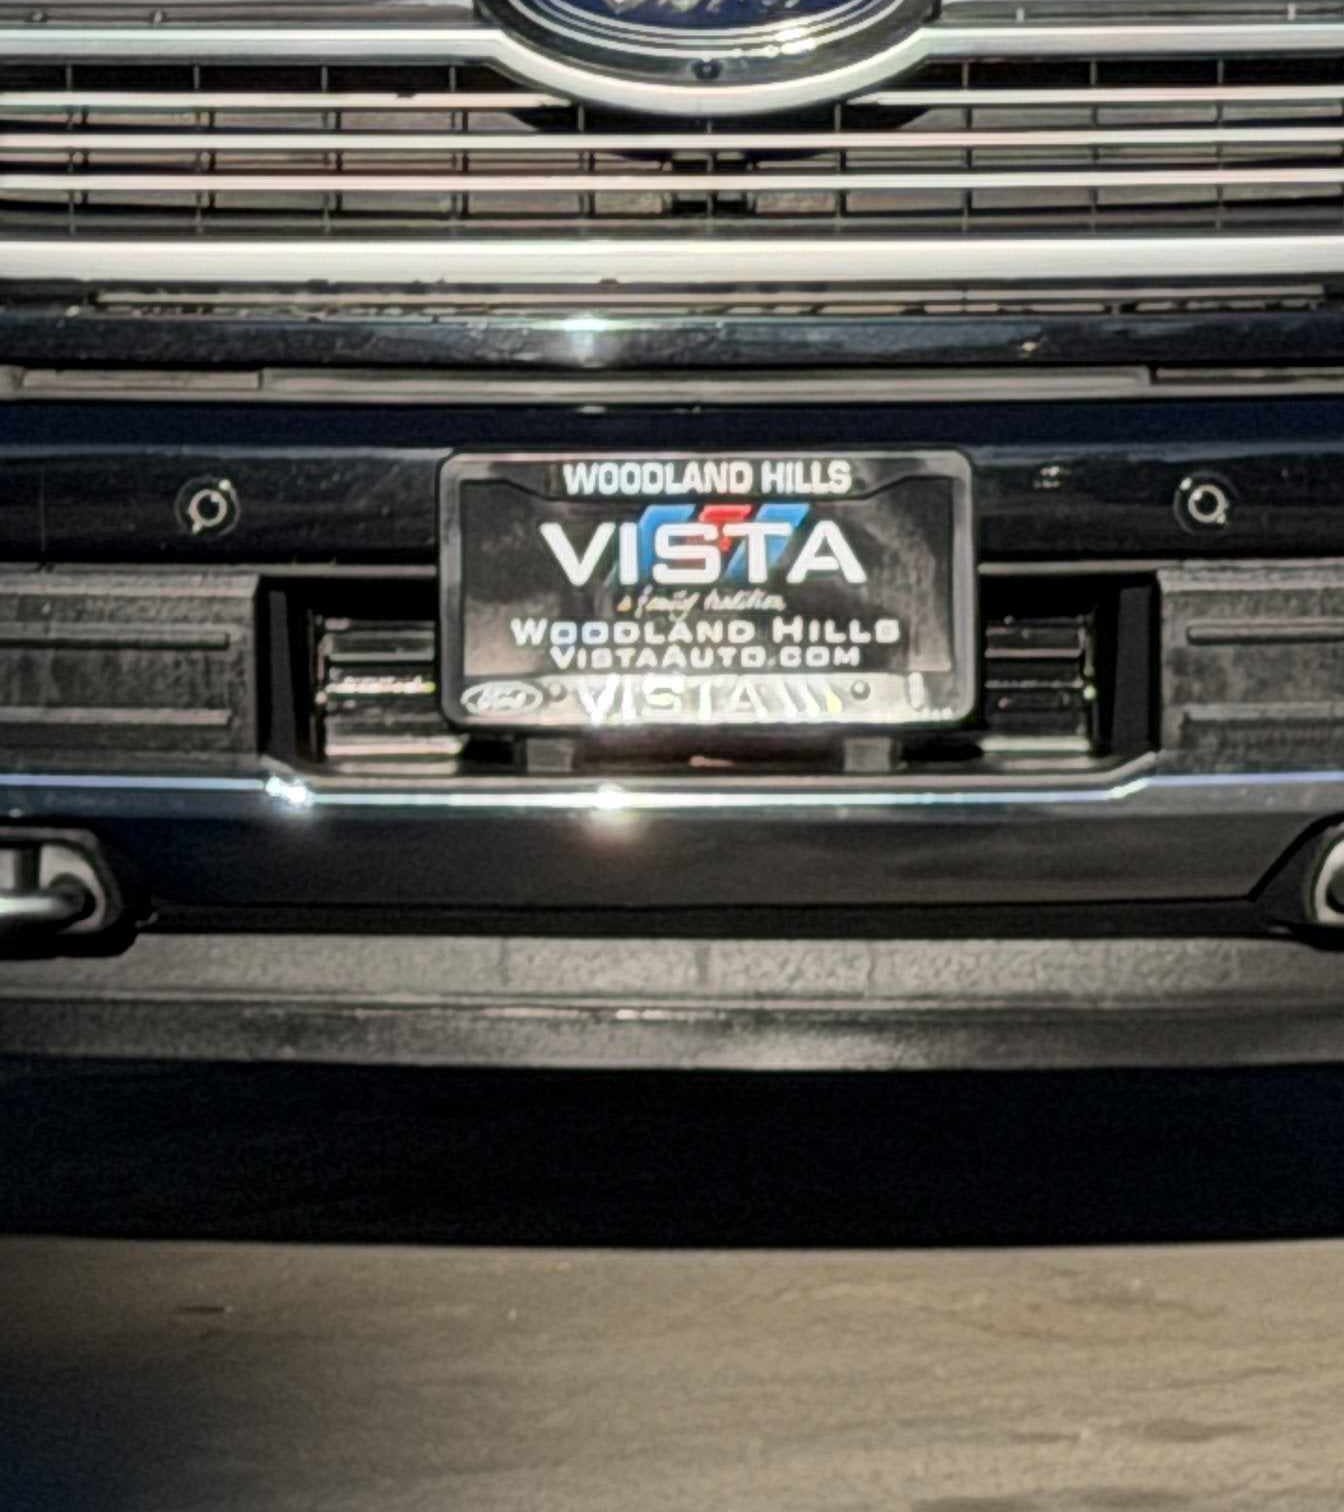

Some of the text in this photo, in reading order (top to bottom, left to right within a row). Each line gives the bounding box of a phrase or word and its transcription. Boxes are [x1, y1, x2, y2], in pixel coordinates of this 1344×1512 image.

[563, 460, 852, 495] WOODLAND HILLS
[539, 520, 868, 586] VISTA
[511, 618, 755, 646] WOODLAND
[577, 672, 768, 724] VISTA
